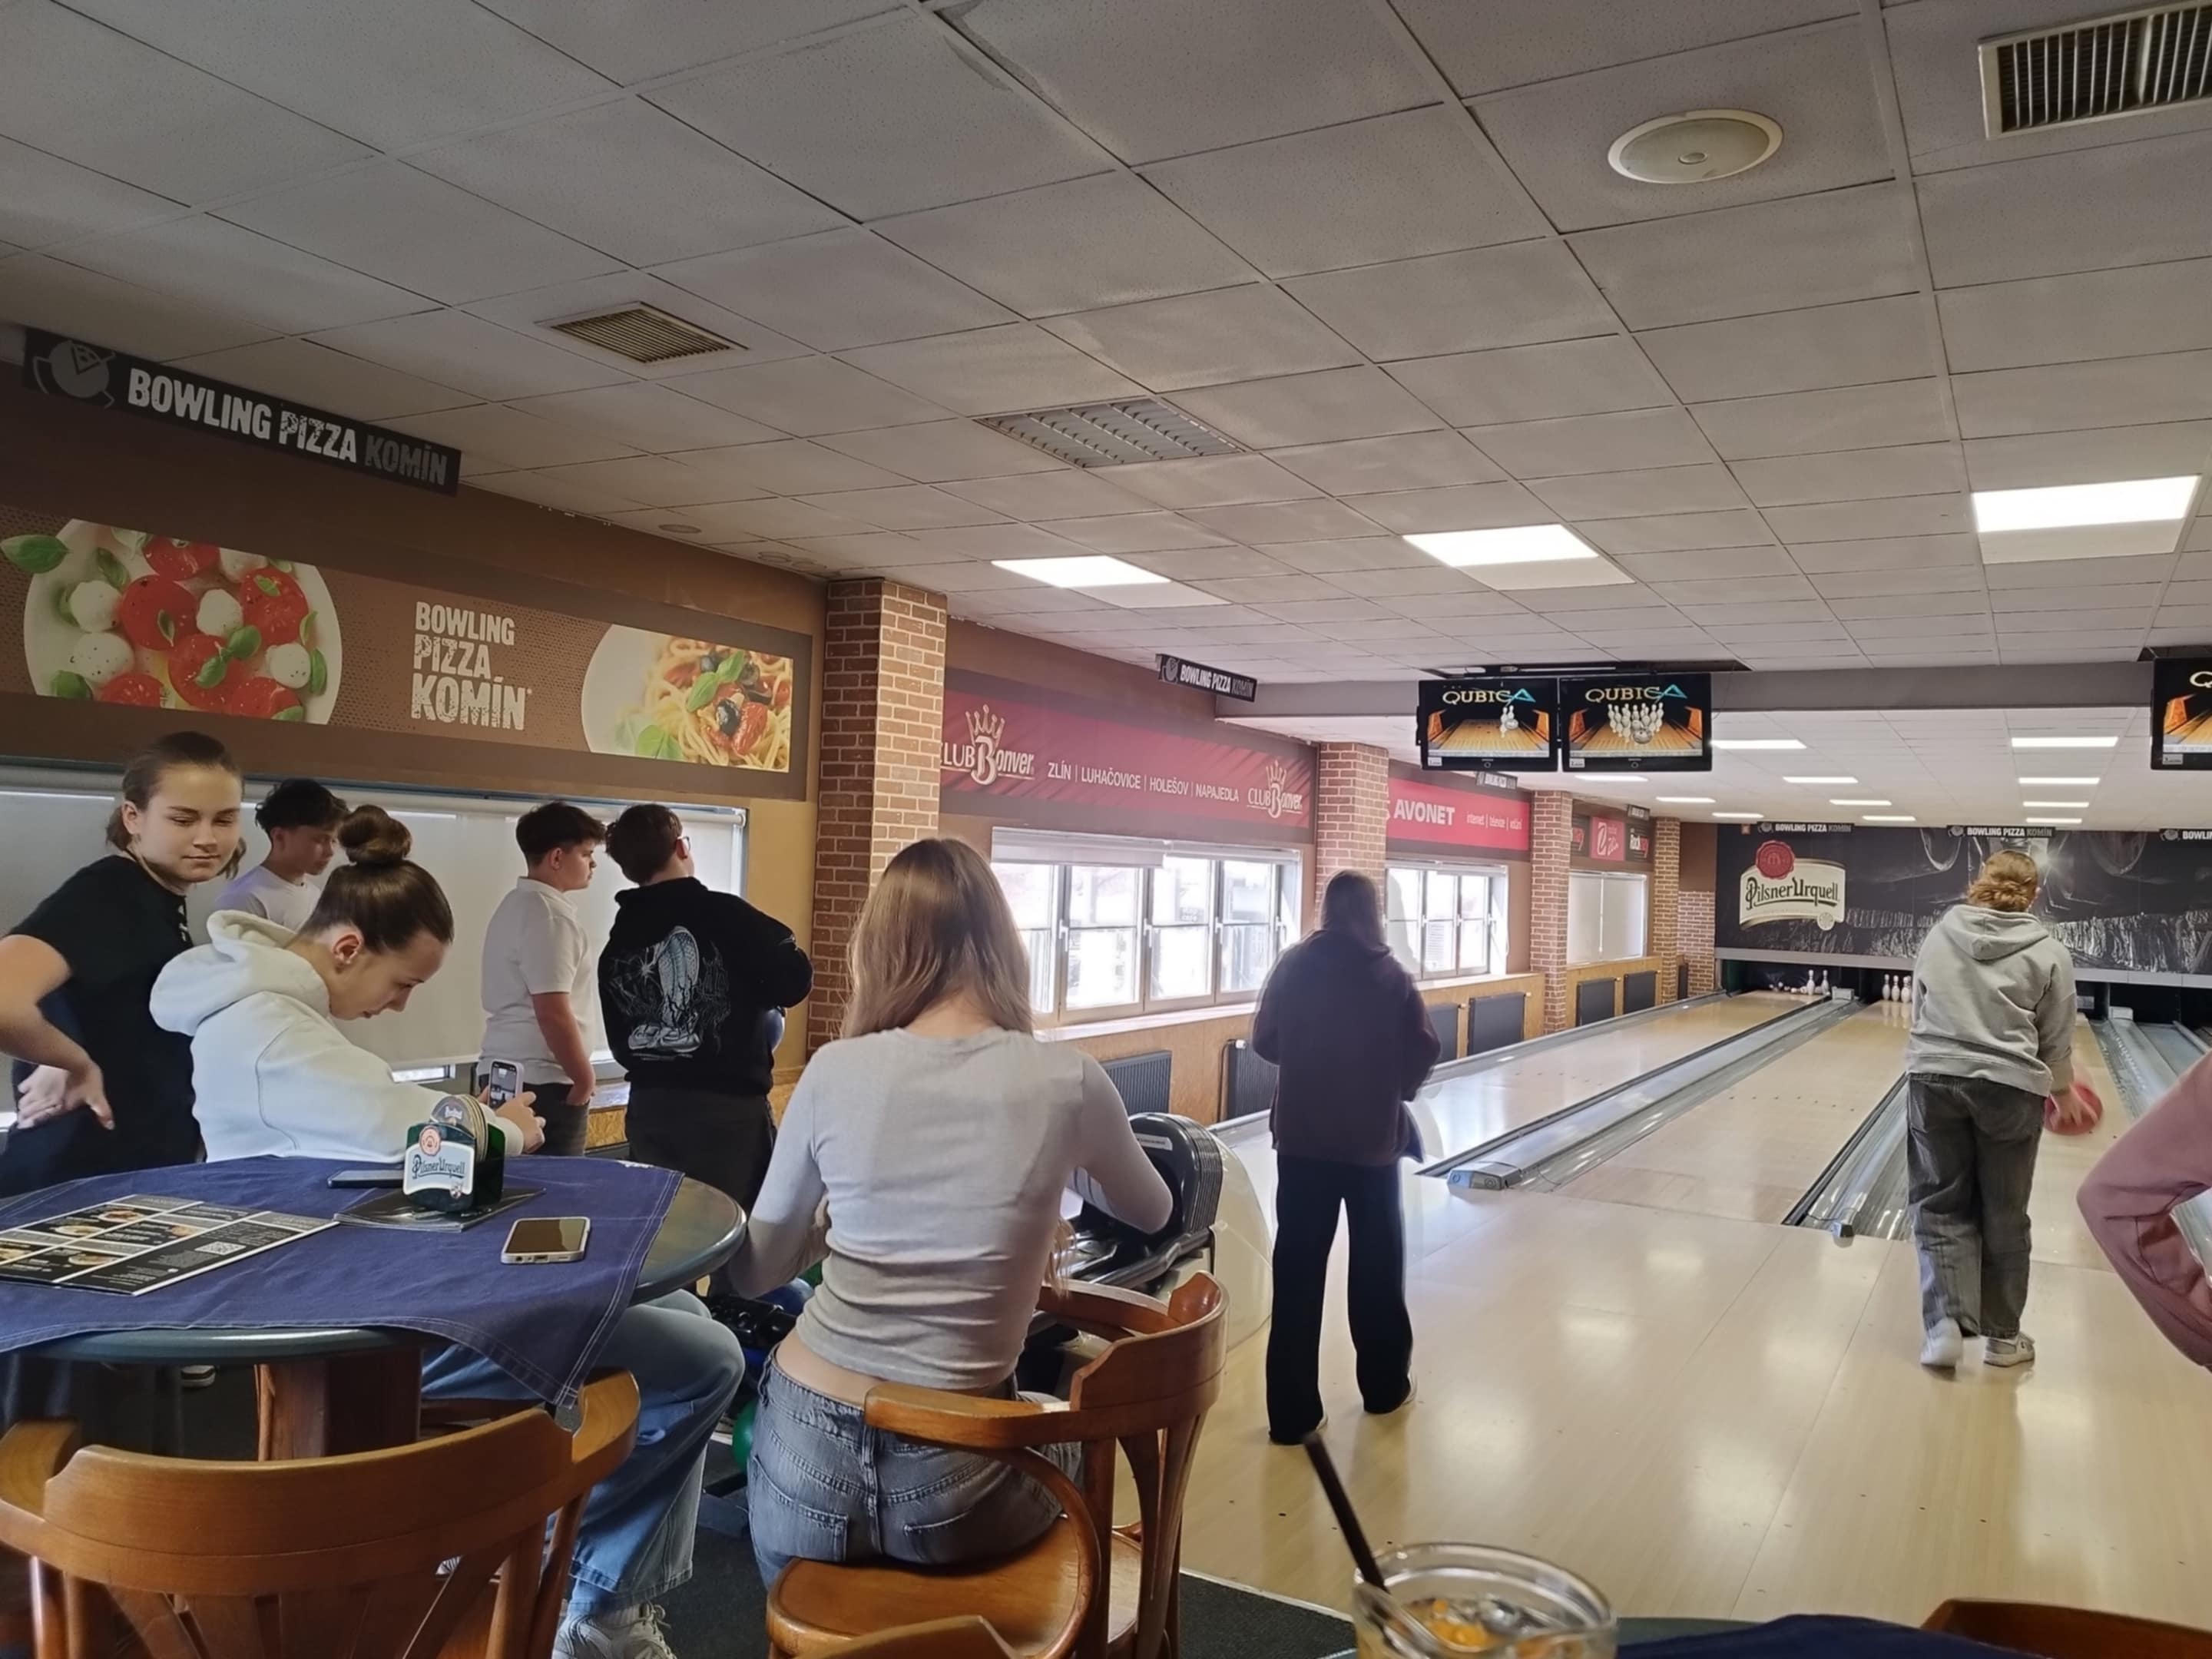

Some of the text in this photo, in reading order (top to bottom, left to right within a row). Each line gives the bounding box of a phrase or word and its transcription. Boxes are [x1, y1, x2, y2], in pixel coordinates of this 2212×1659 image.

[127, 368, 449, 486] BOWLING PIZZA KOMÍN
[415, 601, 515, 646] BOWLING
[413, 633, 492, 680] PIZZA
[1180, 663, 1212, 688] BOWLING
[1211, 673, 1231, 694] PIZZA
[411, 672, 526, 731] KOMÍN
[1048, 760, 1240, 802] ZLÍN LUHAČOVICE HOLEŠOV NAPAJEDLA
[1393, 799, 1455, 826] AVONET
[1775, 823, 1806, 832] BOWLING
[1807, 823, 1828, 833] PIZZA
[1967, 827, 2002, 836] BOWLING
[2003, 828, 2025, 836] PIZZA
[1745, 876, 1839, 910] Pilsner Urquell
[412, 1154, 465, 1180] Pilsner Urquell
